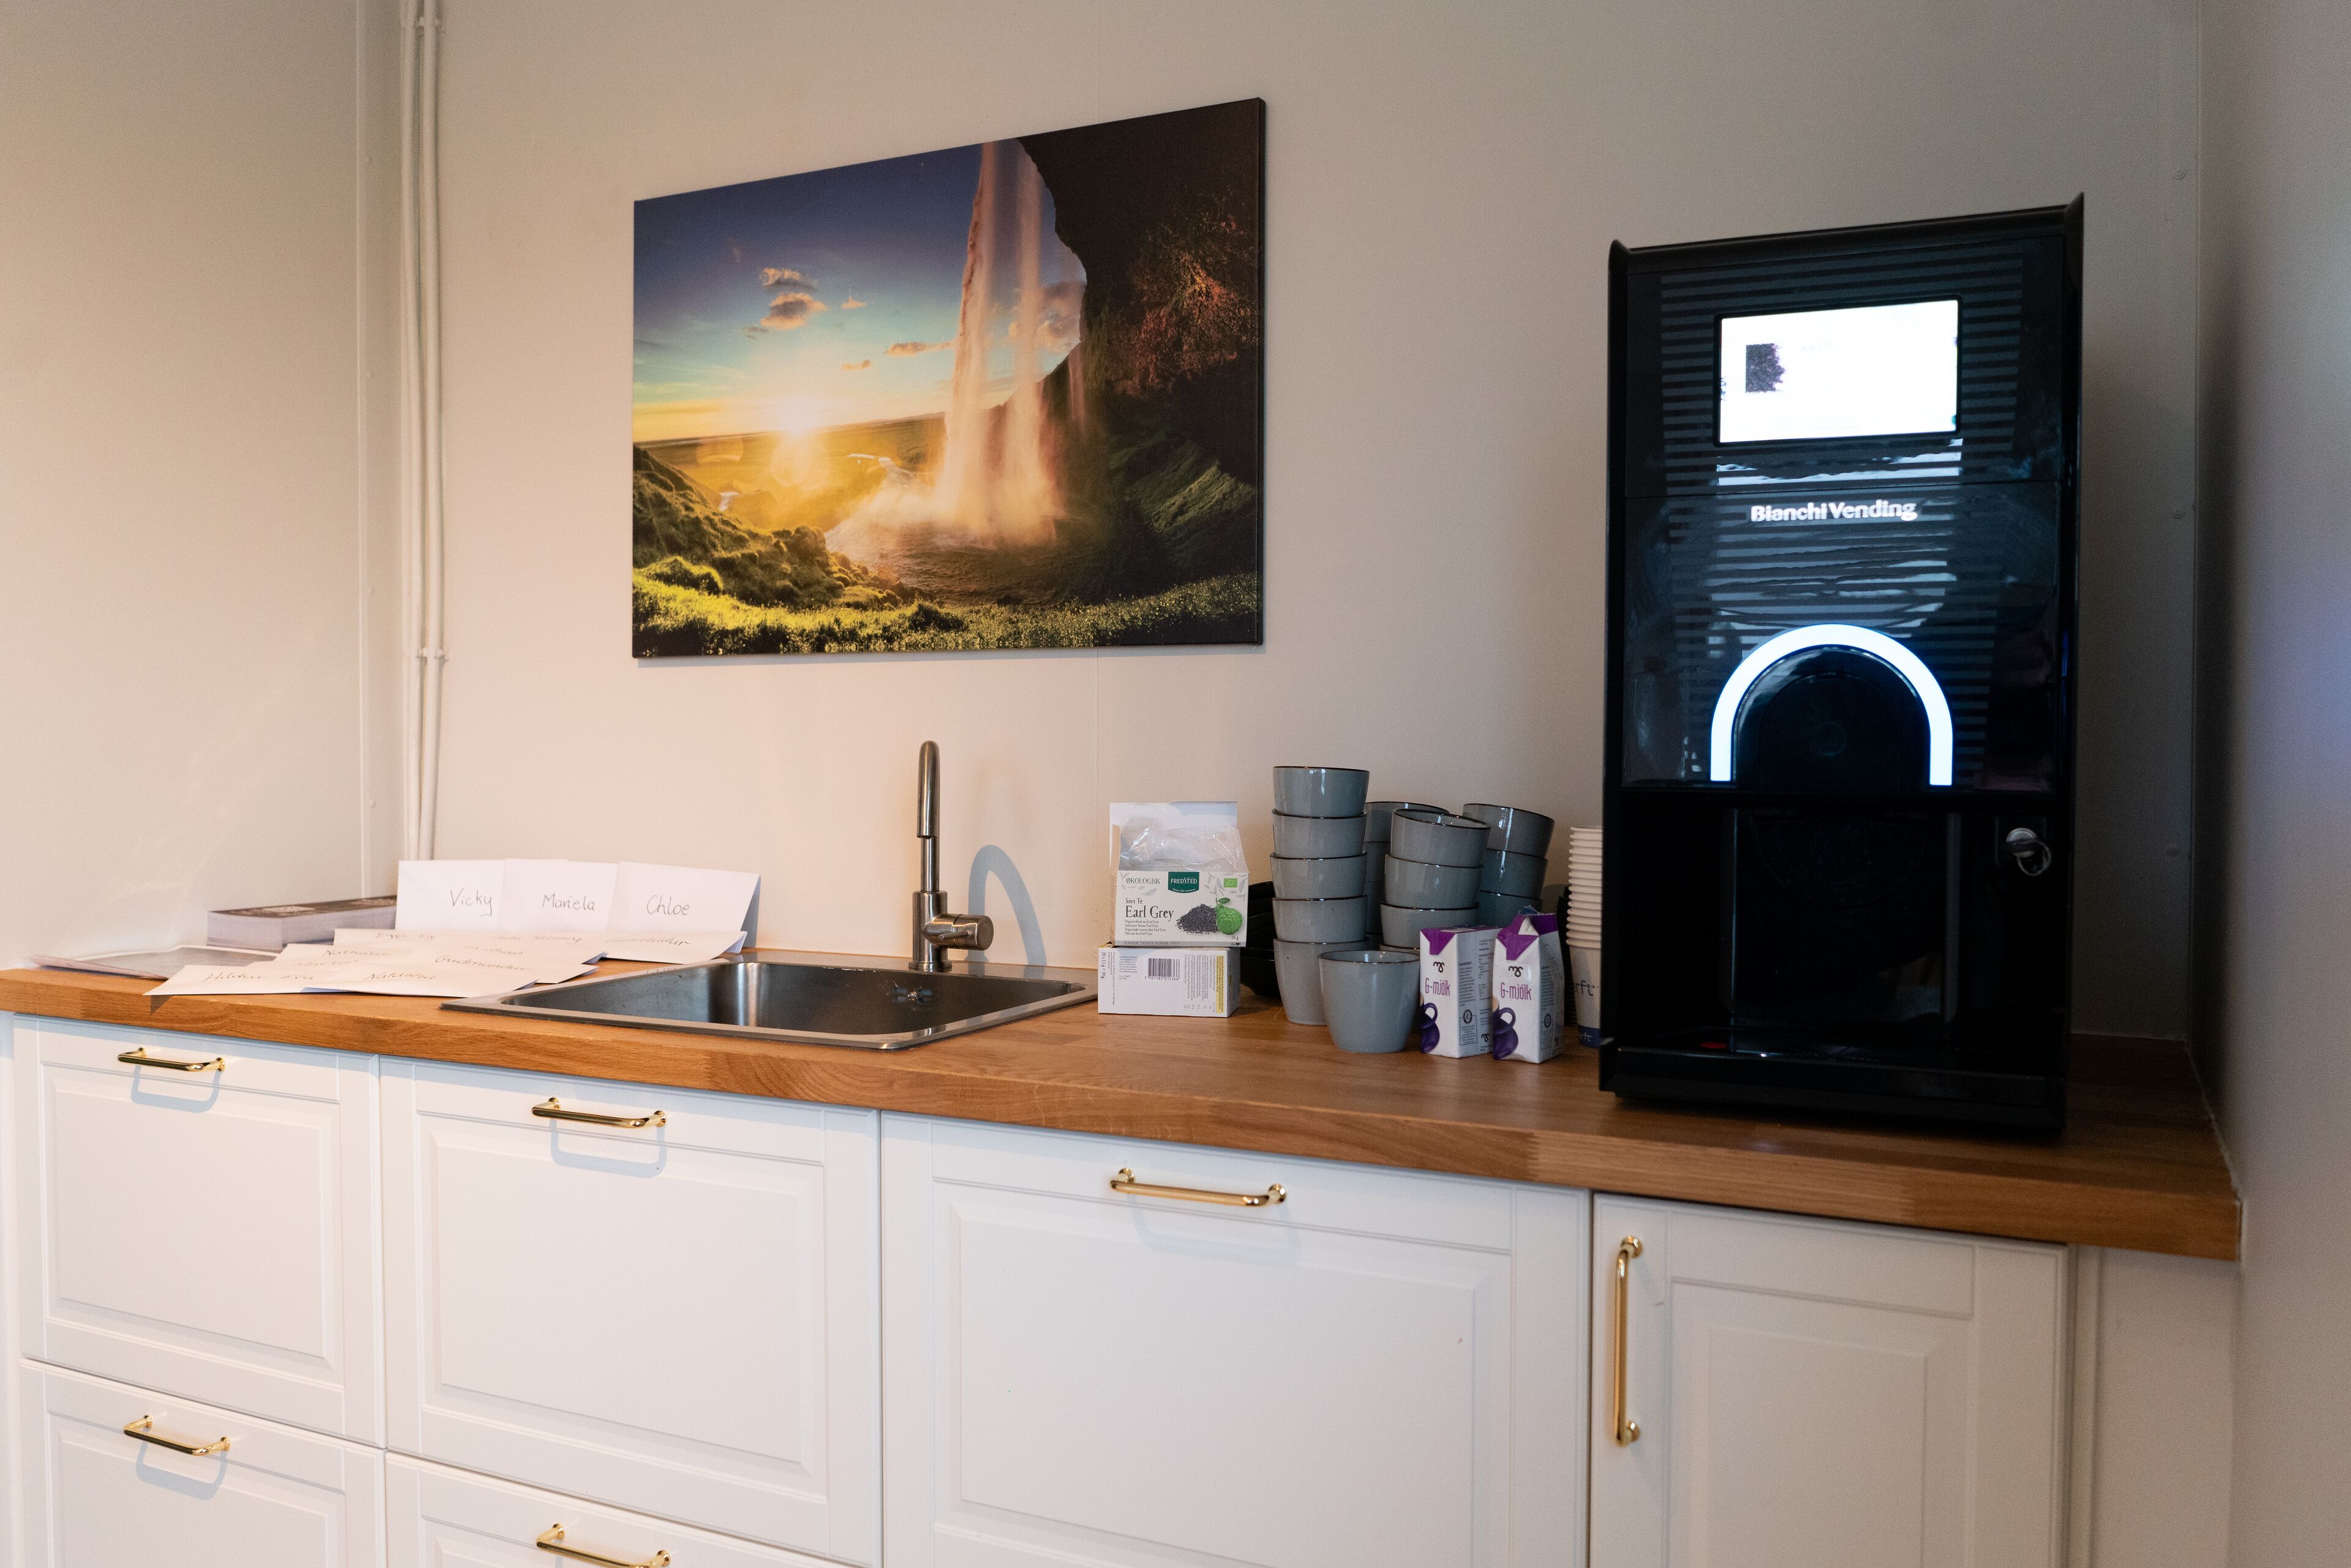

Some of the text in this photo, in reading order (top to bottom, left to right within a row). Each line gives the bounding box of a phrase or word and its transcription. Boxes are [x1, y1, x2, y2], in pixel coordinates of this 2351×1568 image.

[1751, 499, 1918, 522] Bianchi Vending
[449, 888, 493, 917] Vicky
[542, 893, 595, 912] Mariela
[646, 894, 691, 917] Chloe
[1125, 905, 1174, 922] Earl Grey
[1425, 978, 1450, 996] G-mjólk
[1500, 981, 1532, 1000] G-mjólk
